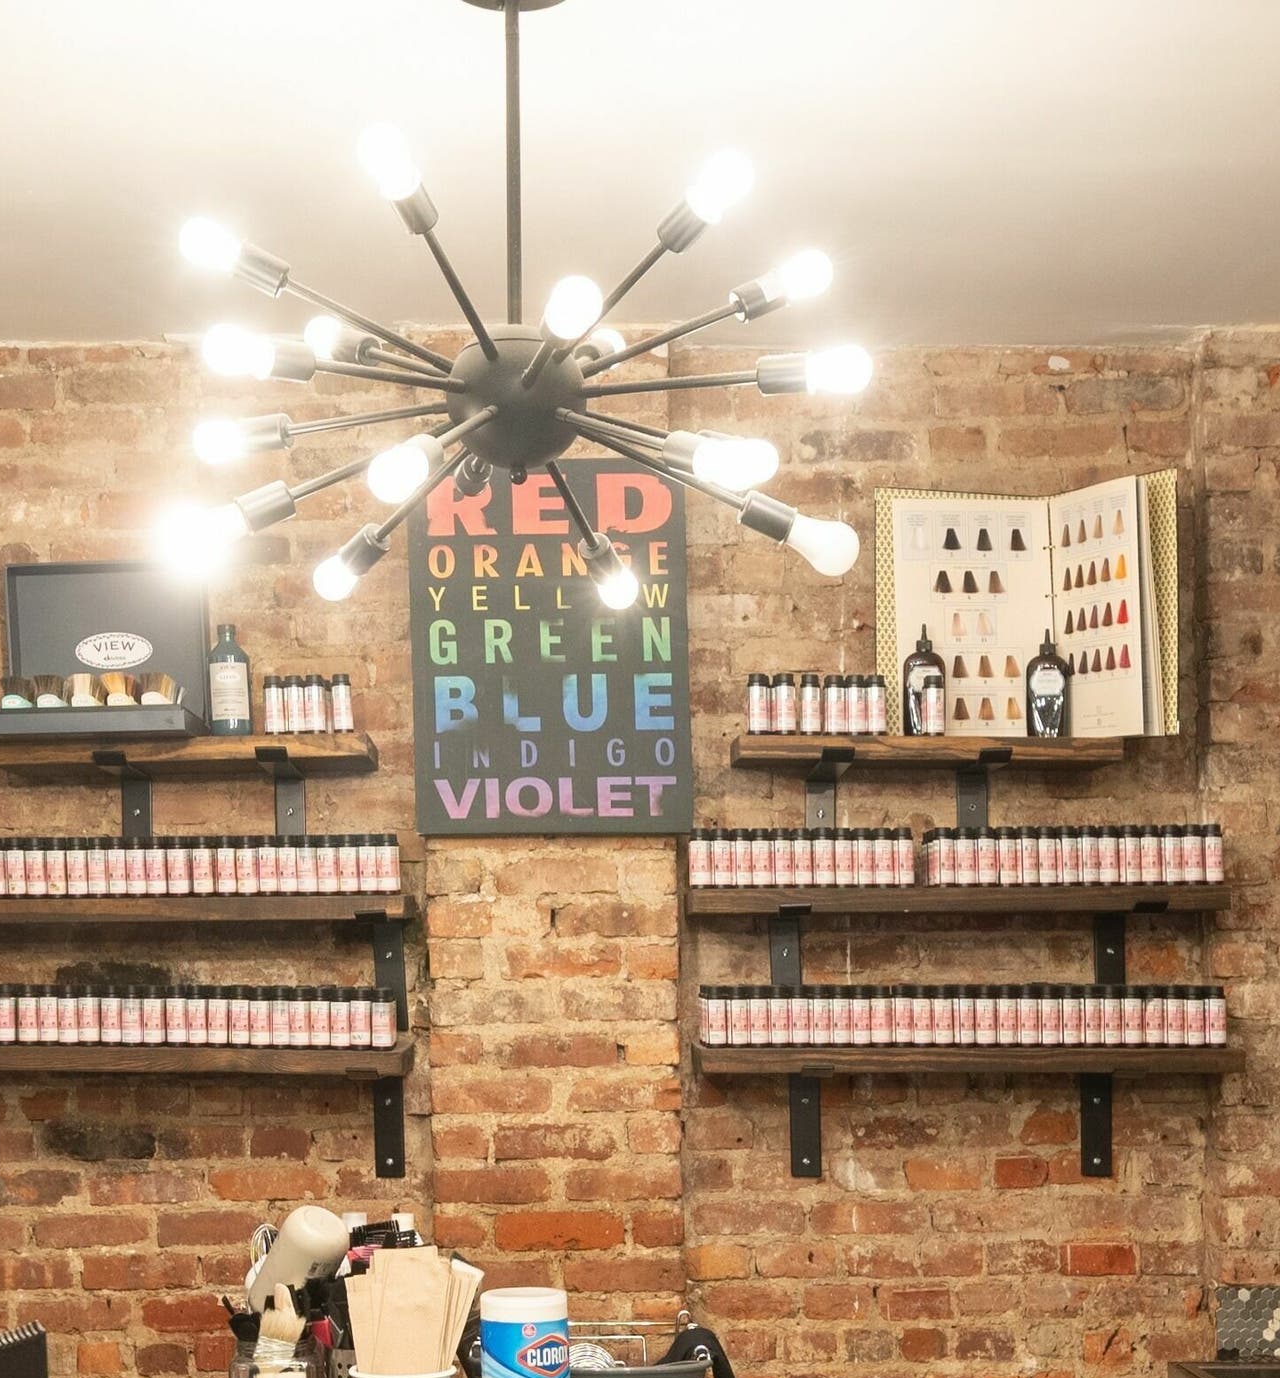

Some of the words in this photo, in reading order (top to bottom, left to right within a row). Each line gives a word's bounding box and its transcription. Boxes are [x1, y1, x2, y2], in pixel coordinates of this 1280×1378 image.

[427, 473, 673, 536] RED
[428, 542, 669, 579] ORANGE
[428, 584, 669, 611] YELLW
[93, 640, 136, 652] VIEW
[429, 617, 672, 665] GREEN
[434, 673, 675, 734] BLUE
[434, 738, 675, 769] INDIGO
[434, 777, 677, 820] VIOLET
